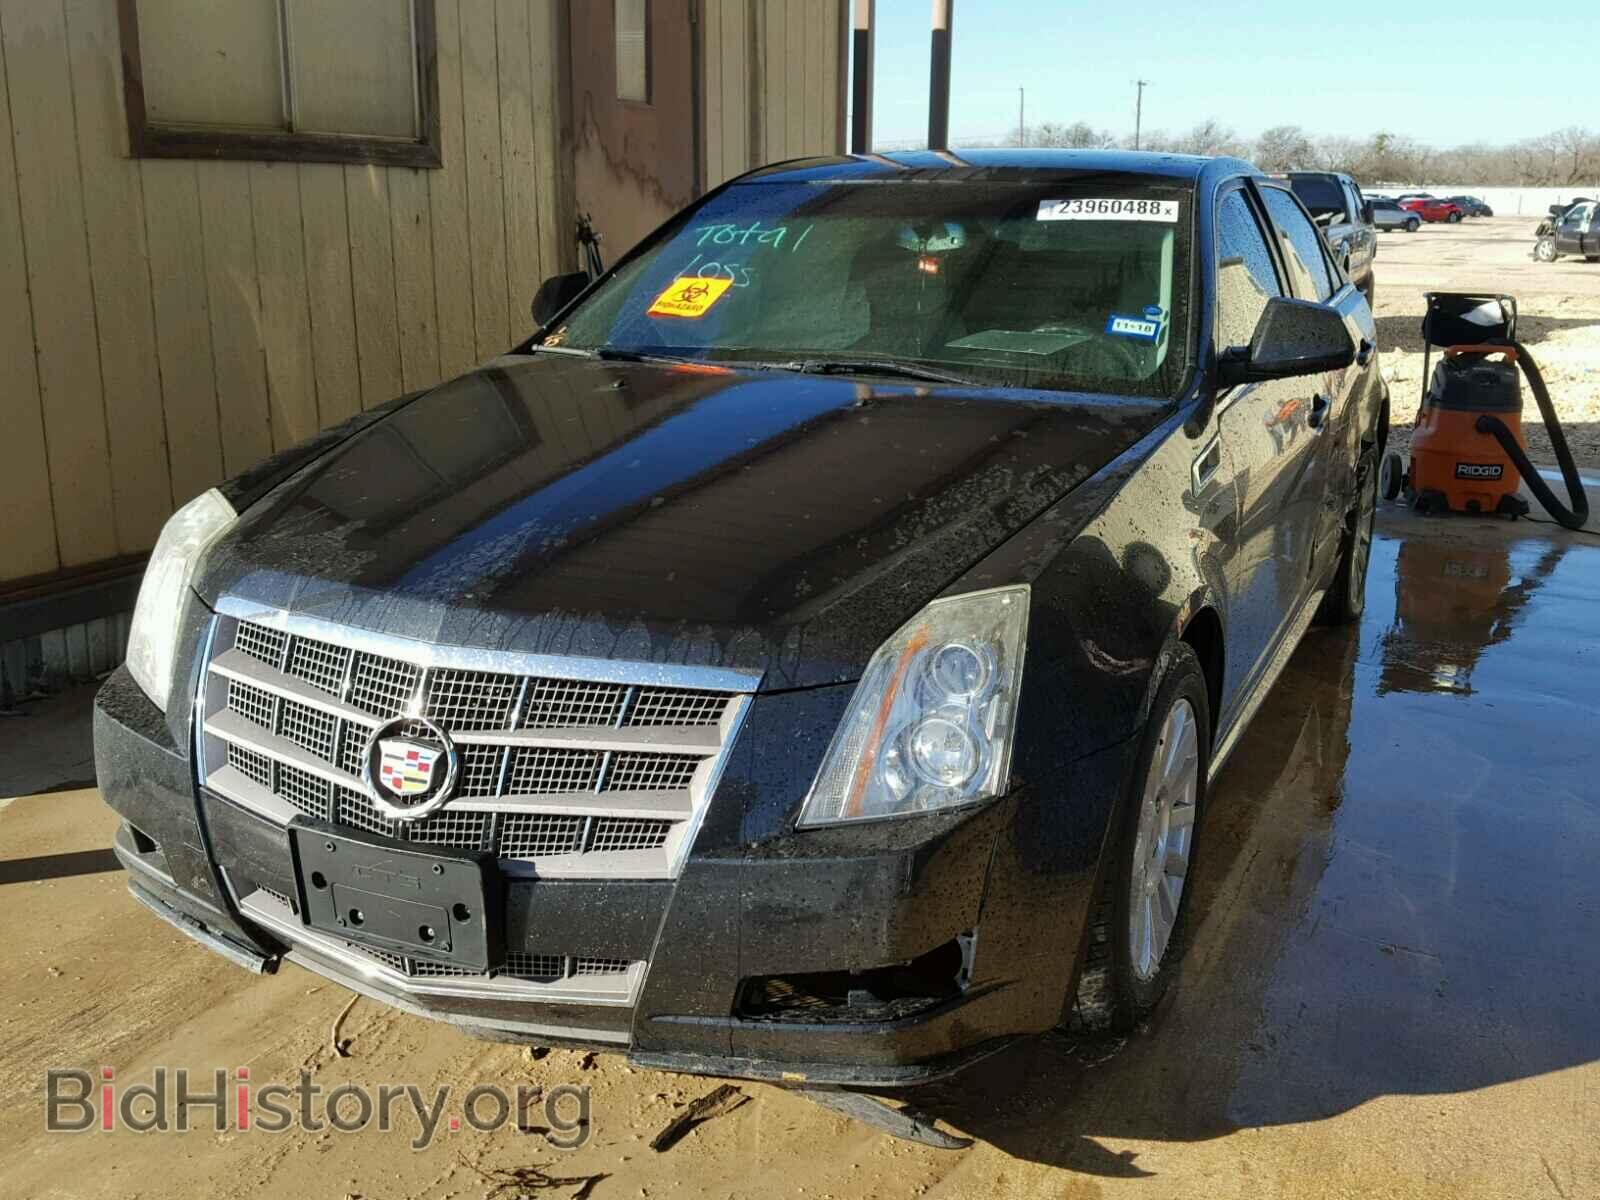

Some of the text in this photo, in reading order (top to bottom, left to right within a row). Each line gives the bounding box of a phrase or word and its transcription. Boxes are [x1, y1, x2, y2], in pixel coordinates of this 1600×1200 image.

[1059, 200, 1160, 215] 23960488
[656, 301, 704, 312] BIOHAZARD
[1457, 464, 1502, 476] RIDGID
